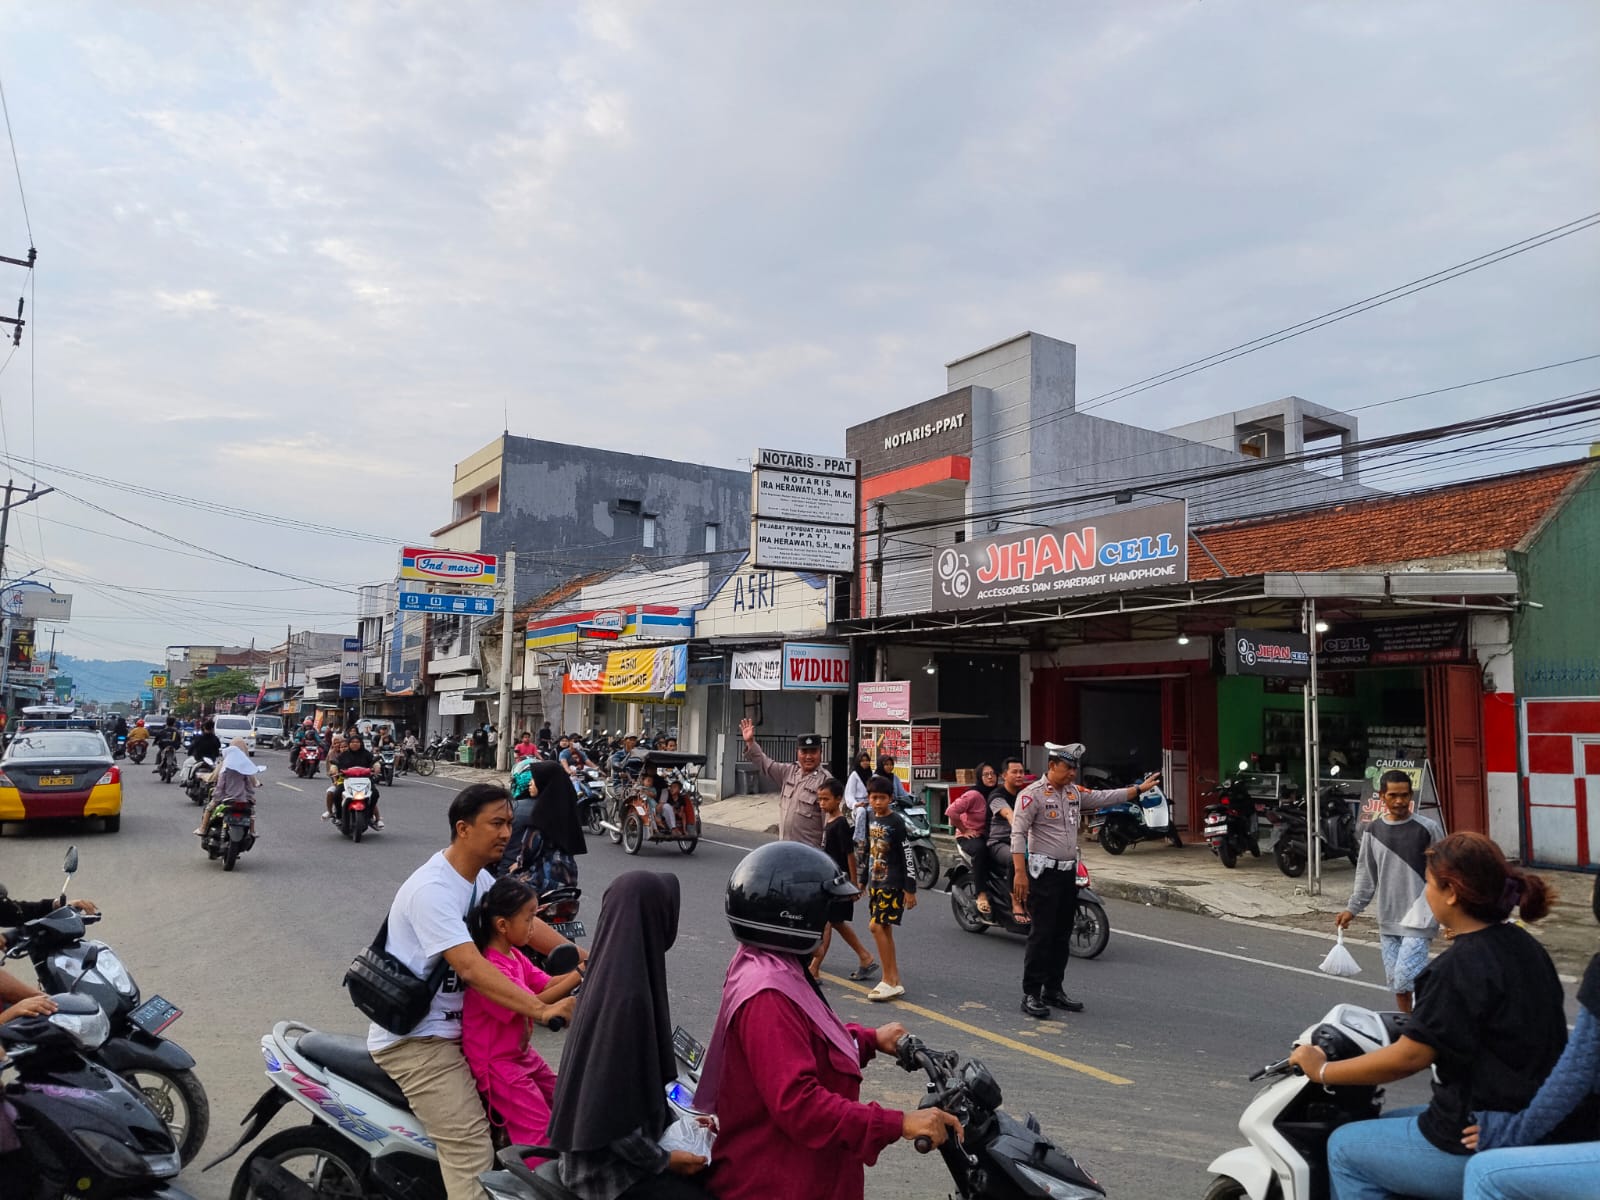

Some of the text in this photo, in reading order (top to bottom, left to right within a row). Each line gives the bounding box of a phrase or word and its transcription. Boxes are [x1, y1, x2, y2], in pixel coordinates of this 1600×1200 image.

[884, 413, 965, 450] NOTARIS-PPAT
[762, 451, 814, 469] NOTARIS
[824, 459, 852, 473] PPAT
[760, 480, 773, 490] IRA
[775, 483, 815, 496] HERAWATI,
[783, 475, 831, 487] NOTARIS
[759, 523, 785, 531] PEJABAT
[759, 536, 772, 544] IRA
[977, 526, 1179, 584] JIHAN CELL
[977, 564, 1176, 600] ACCESSORIES DAN SPAREPART HANDPHONE
[734, 570, 774, 612] ASRI
[1256, 644, 1291, 660] JIHAN
[763, 661, 780, 680] NOT
[608, 673, 648, 687] FURNITURE
[1375, 759, 1415, 768] CAUTION
[915, 768, 936, 778] PIZZA
[902, 840, 916, 880] MOBILE
